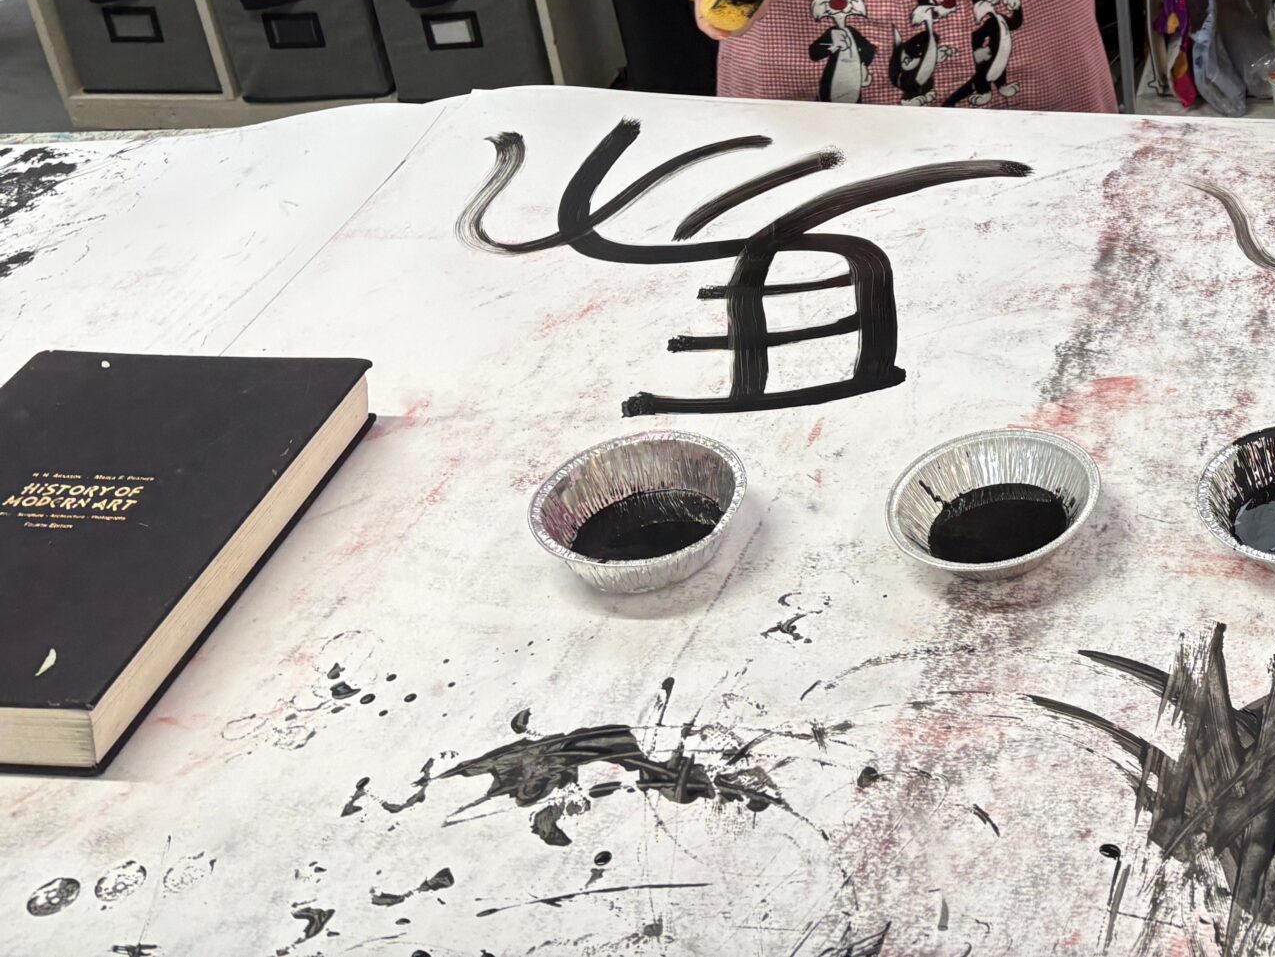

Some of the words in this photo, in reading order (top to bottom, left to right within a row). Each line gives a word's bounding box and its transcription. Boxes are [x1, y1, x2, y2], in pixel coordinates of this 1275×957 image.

[114, 485, 145, 498] OF
[2, 494, 92, 510] MODERN
[92, 498, 138, 512] ART
